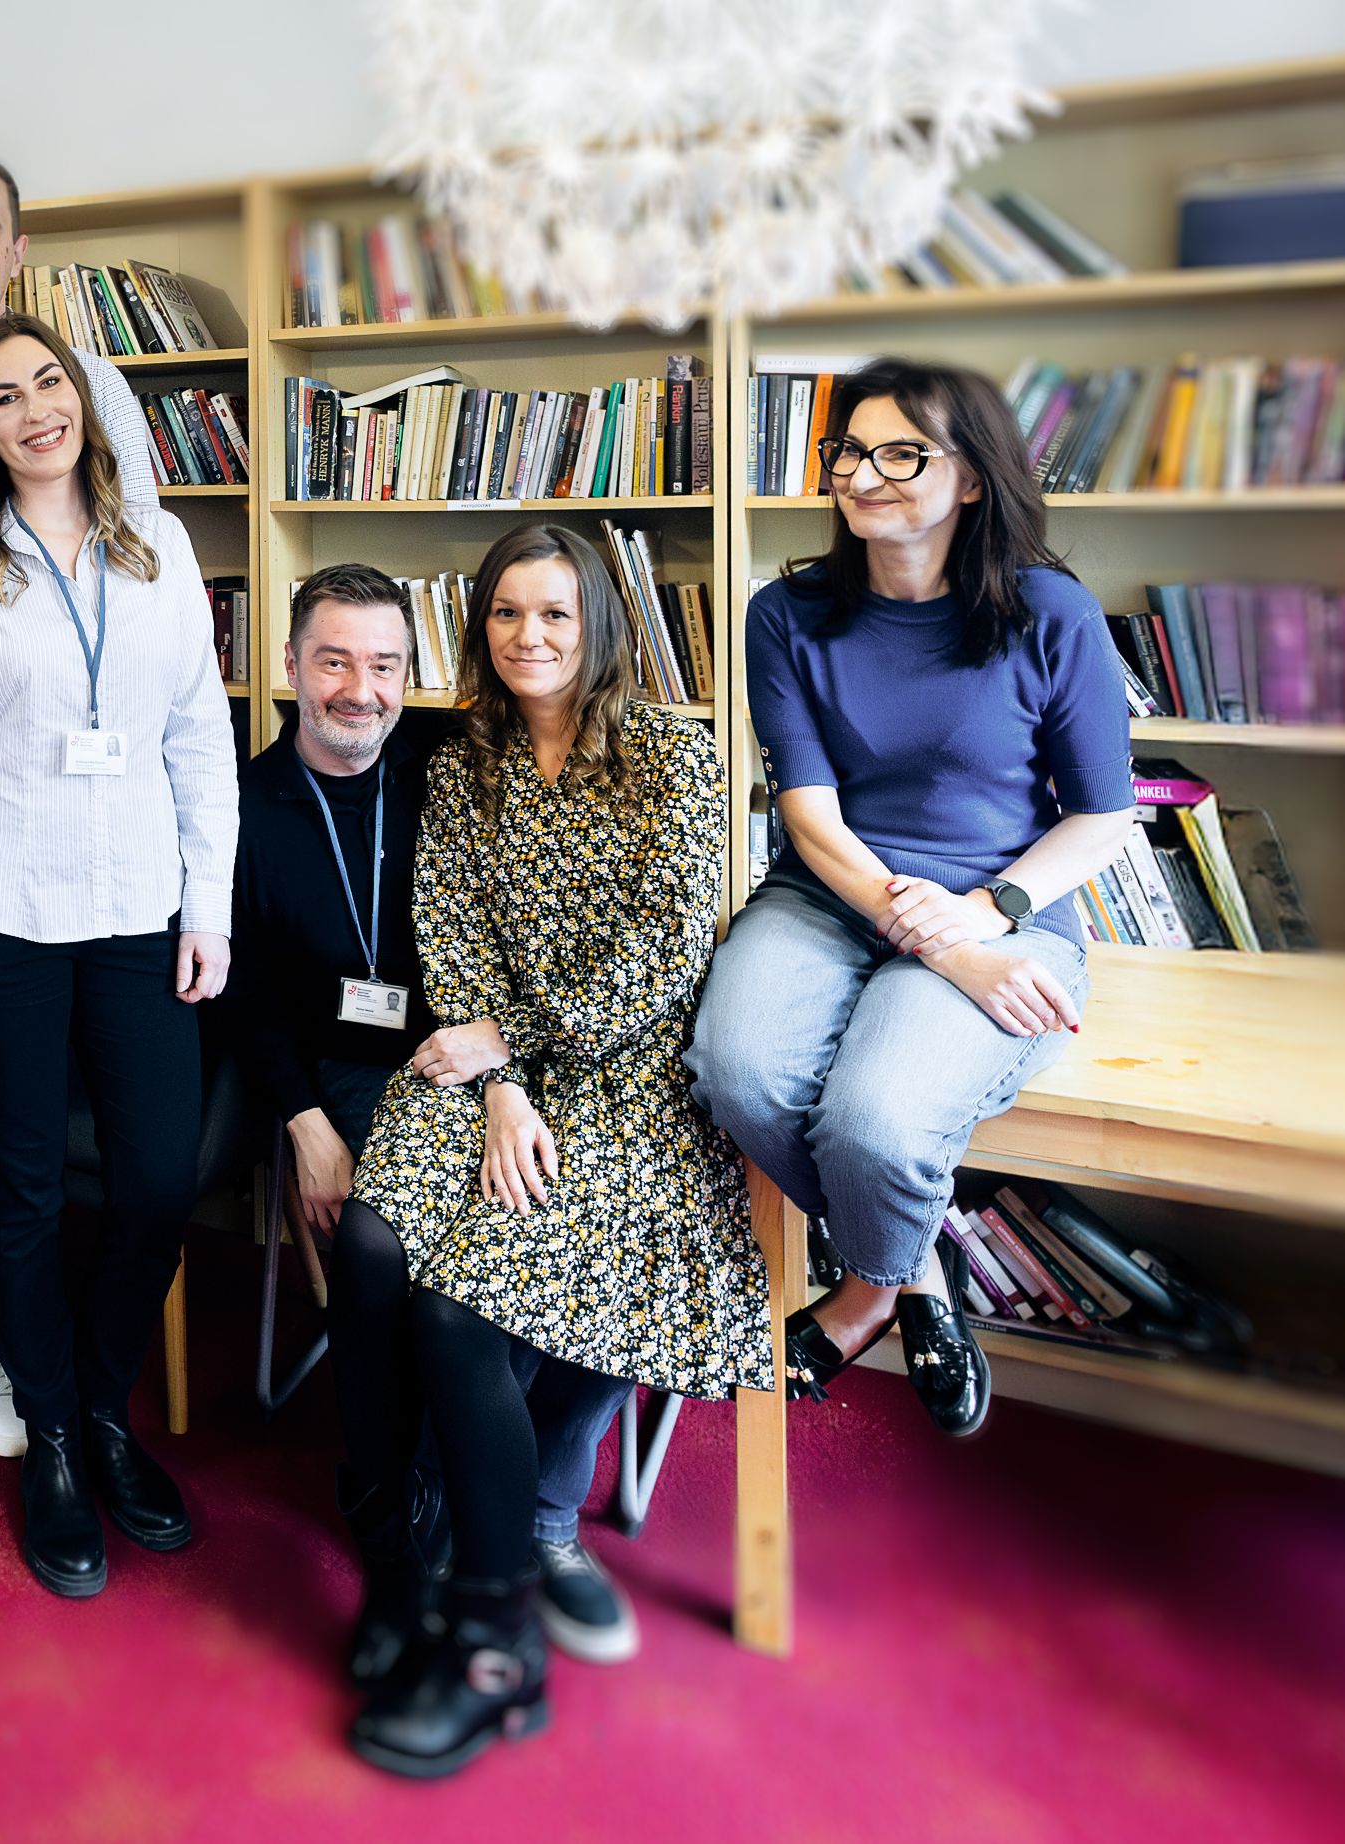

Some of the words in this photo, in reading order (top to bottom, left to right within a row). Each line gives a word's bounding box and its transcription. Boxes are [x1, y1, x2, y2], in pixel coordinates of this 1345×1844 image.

[671, 384, 684, 424] Rankin
[693, 378, 710, 413] Prus
[321, 404, 331, 435] MANN
[318, 439, 329, 482] HENRYK
[1134, 784, 1174, 800] ANKELL
[1115, 857, 1133, 884] AGIS
